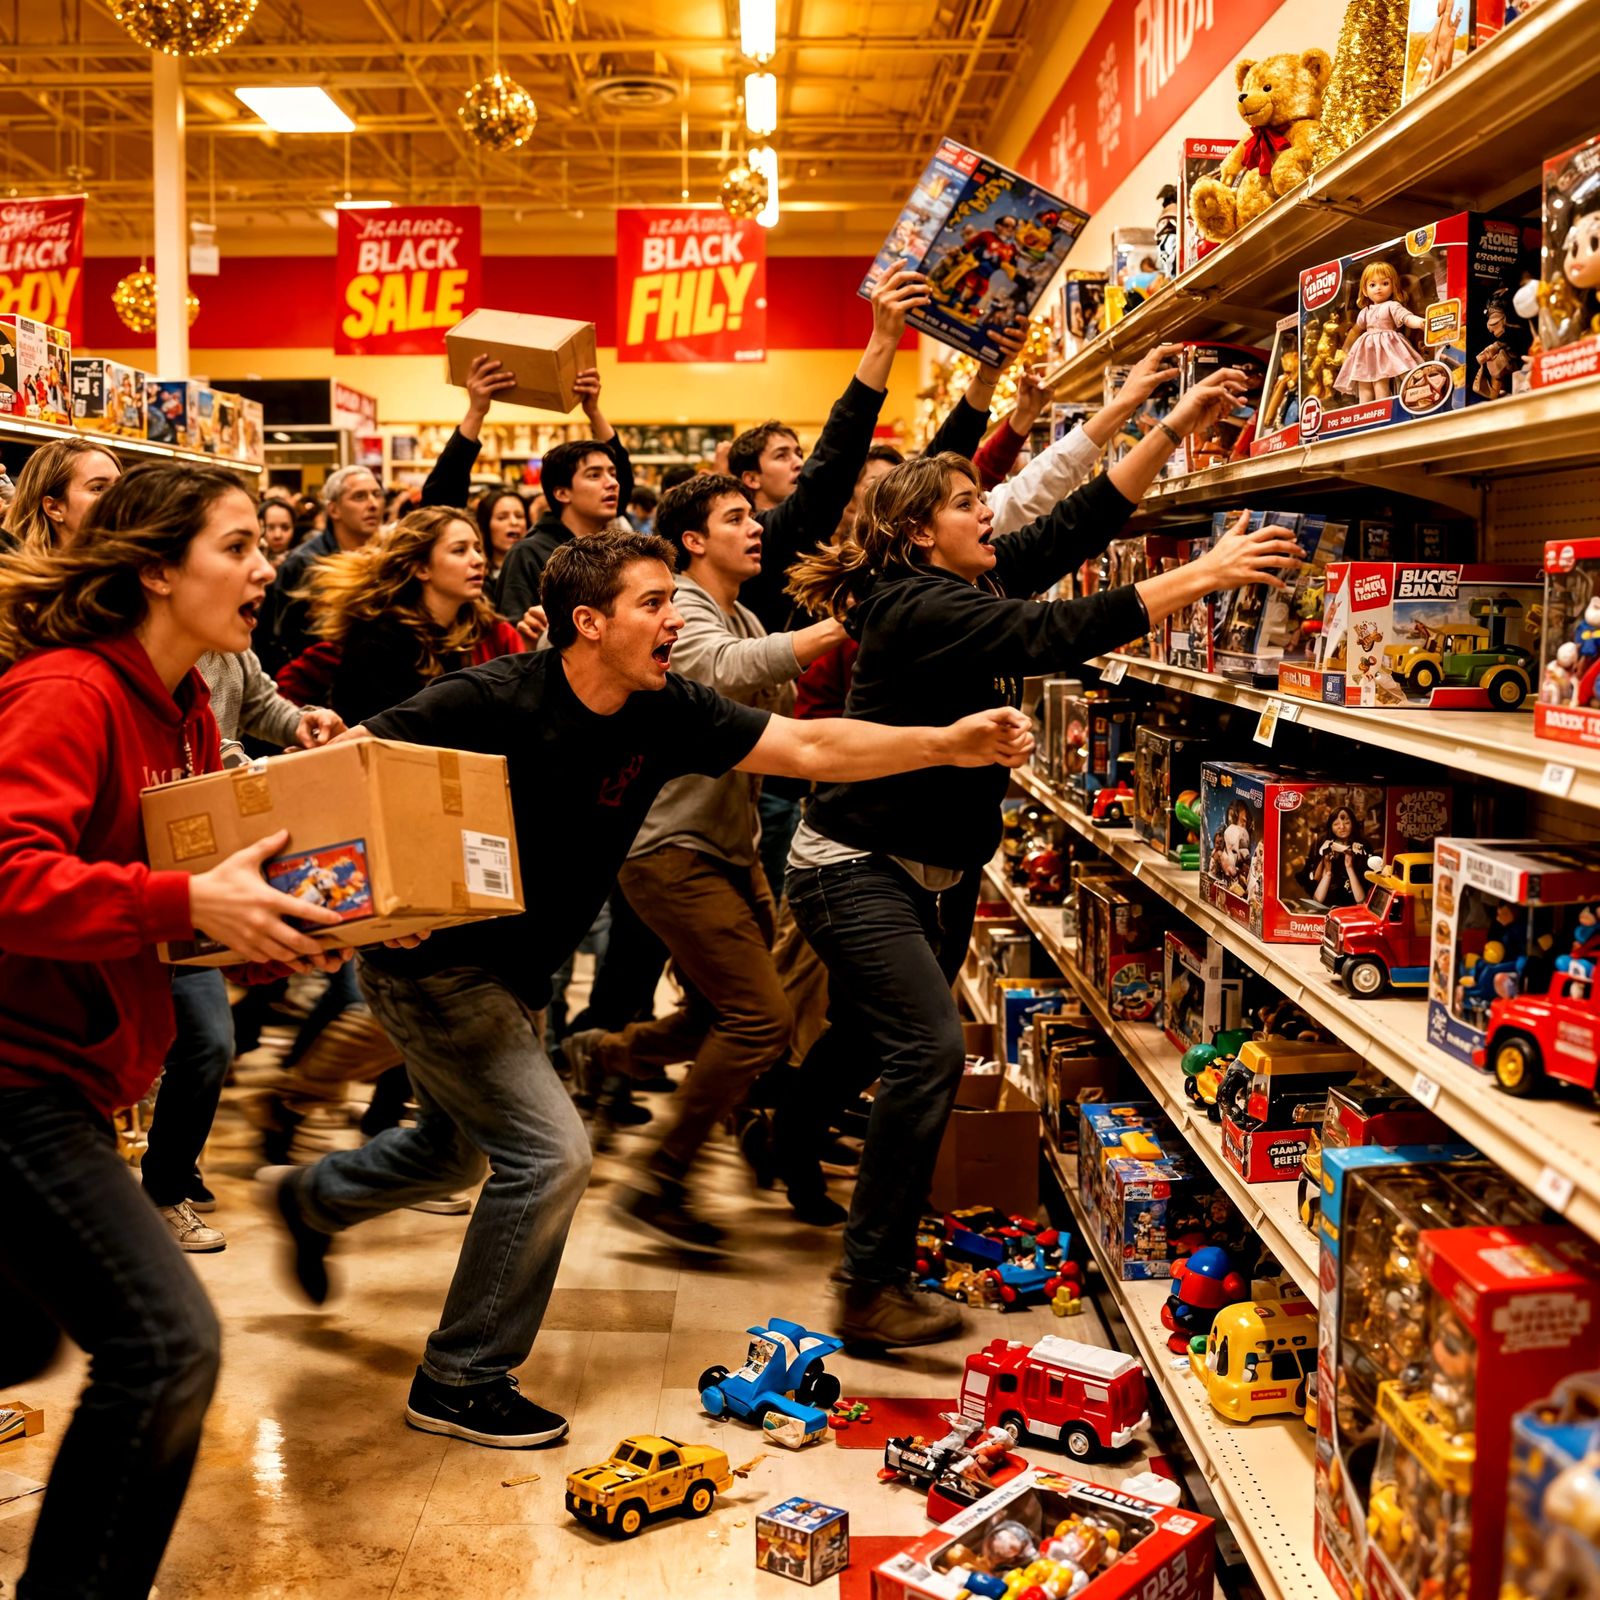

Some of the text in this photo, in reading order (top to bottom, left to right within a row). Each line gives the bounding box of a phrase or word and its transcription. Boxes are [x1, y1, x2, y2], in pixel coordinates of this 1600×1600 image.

[357, 237, 459, 273] BLACK
[642, 231, 744, 272] BLACK
[342, 269, 468, 339] SALE
